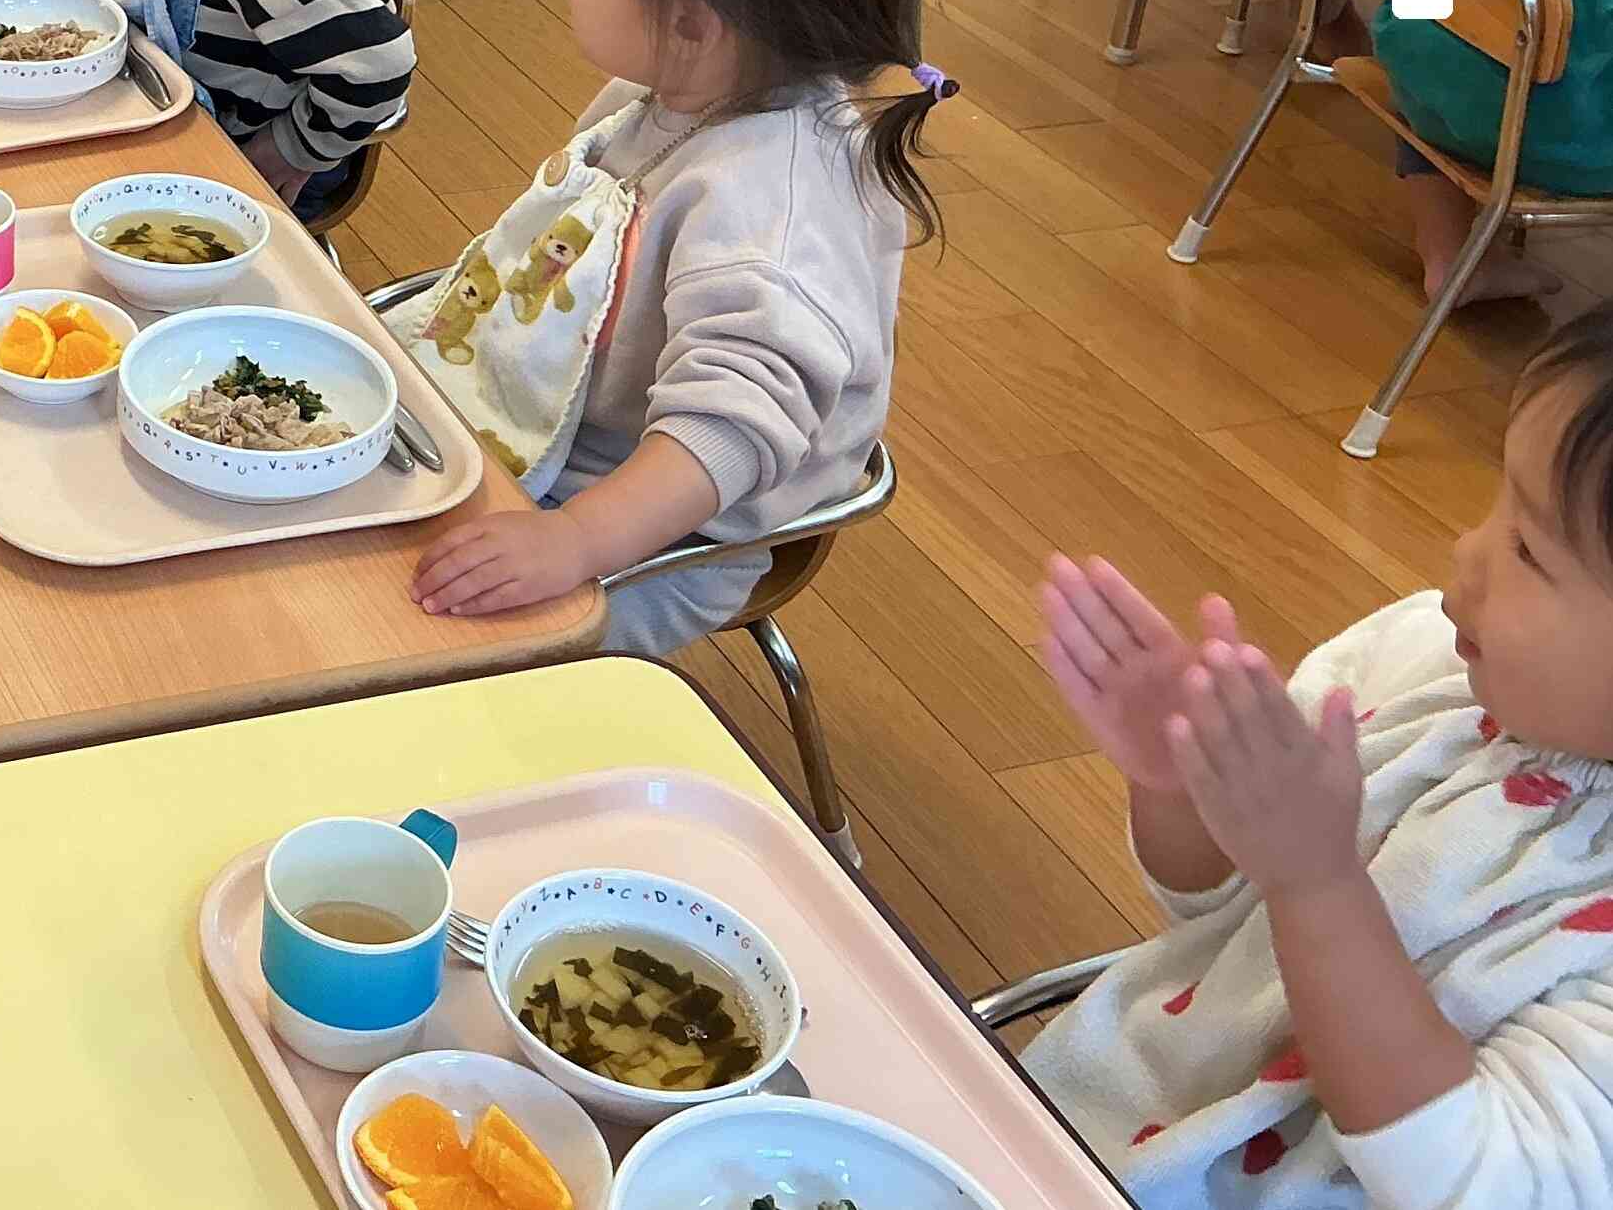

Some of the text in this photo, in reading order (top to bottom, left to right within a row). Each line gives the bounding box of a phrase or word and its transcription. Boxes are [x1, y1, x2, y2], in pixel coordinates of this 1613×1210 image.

[123, 184, 134, 194] Q
[165, 186, 174, 196] S
[205, 195, 214, 204] U
[143, 423, 151, 436] Q
[186, 451, 194, 461] S
[237, 466, 247, 475] U
[269, 460, 277, 470] V
[295, 462, 307, 471] W
[594, 877, 603, 890] B
[620, 888, 632, 899] C
[655, 890, 668, 903] D
[689, 902, 703, 916] E
[715, 923, 725, 937] F
[740, 936, 751, 950] G
